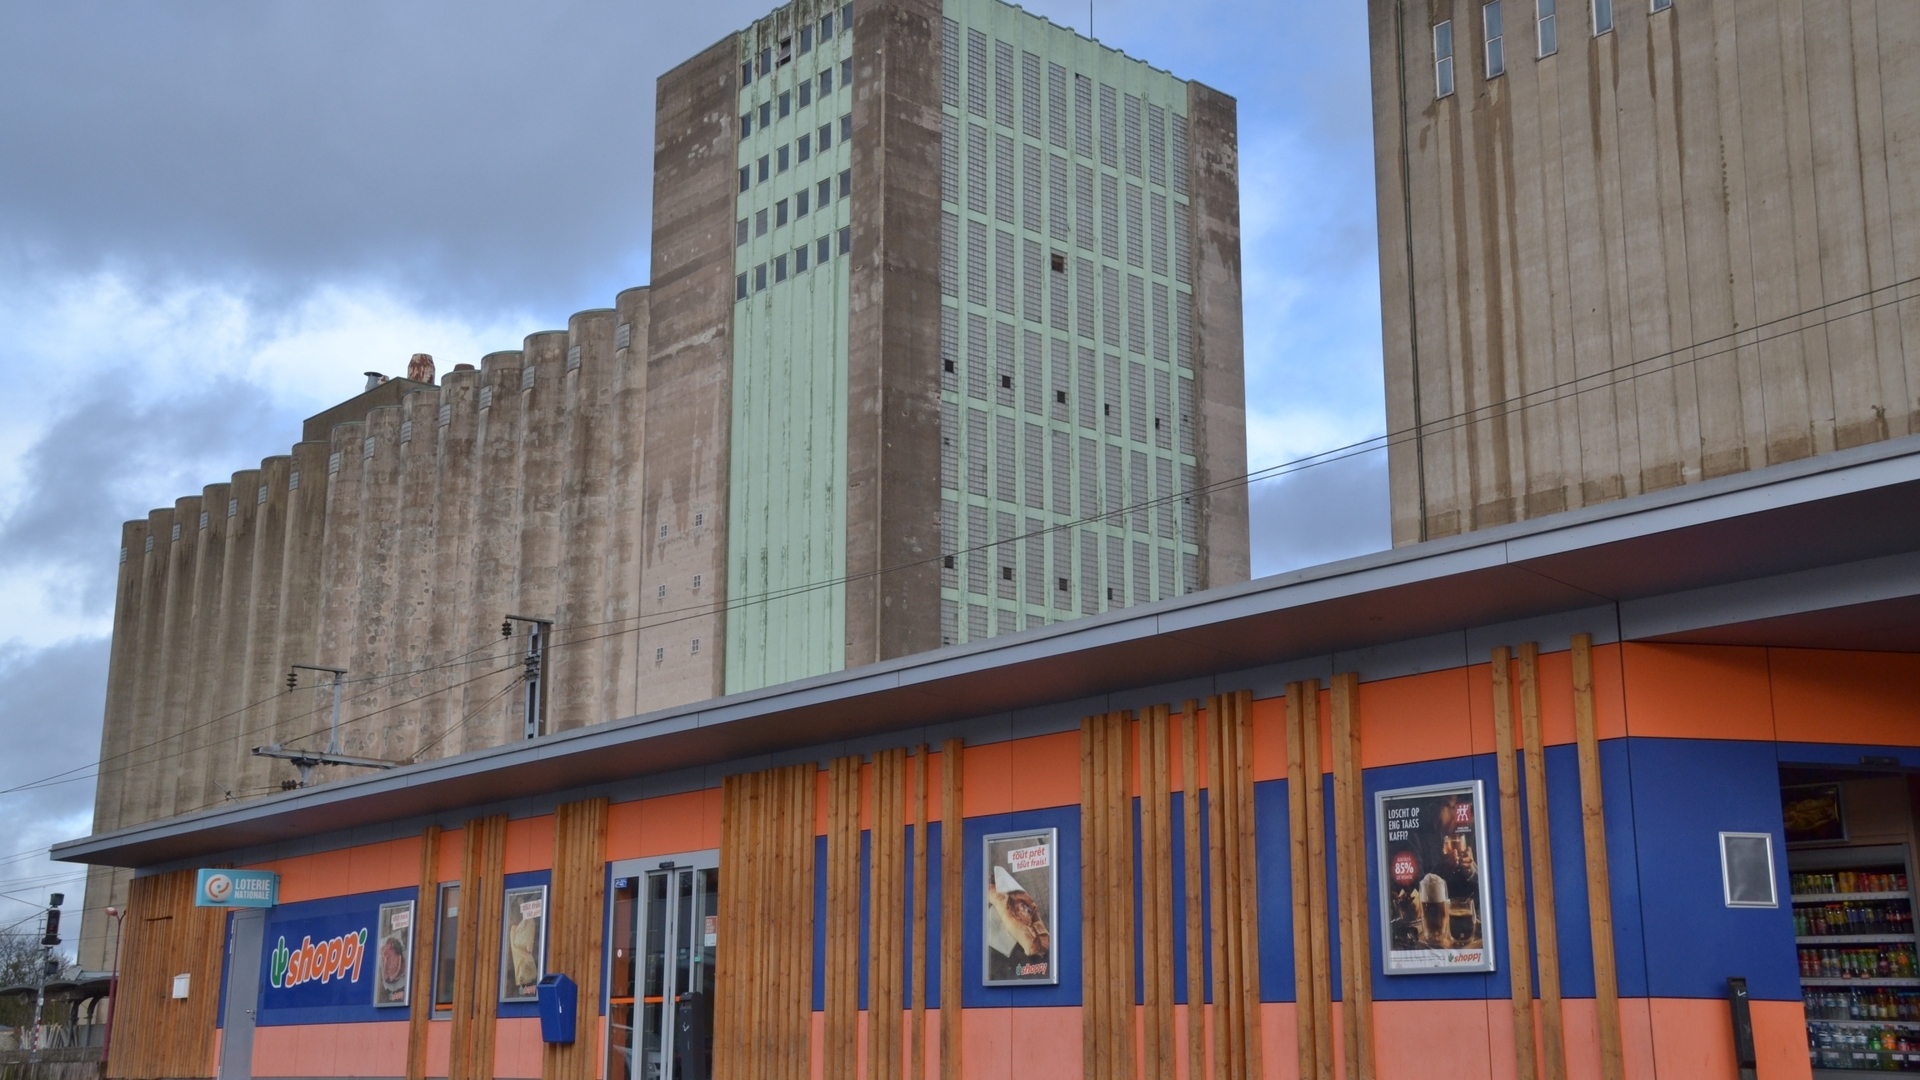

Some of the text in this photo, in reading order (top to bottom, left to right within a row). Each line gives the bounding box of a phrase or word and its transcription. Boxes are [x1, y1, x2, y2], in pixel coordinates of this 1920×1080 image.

[1388, 807, 1420, 819] LOSCHT OP
[1389, 818, 1420, 830] ENG TAASS
[1389, 830, 1409, 841] KAFFI?
[1029, 847, 1045, 860] prêt
[1395, 862, 1414, 874] 85%
[235, 879, 271, 891] LOTERIE
[234, 890, 270, 900] NATIONALE
[285, 927, 368, 988] shoppi
[1454, 952, 1482, 963] shoppi
